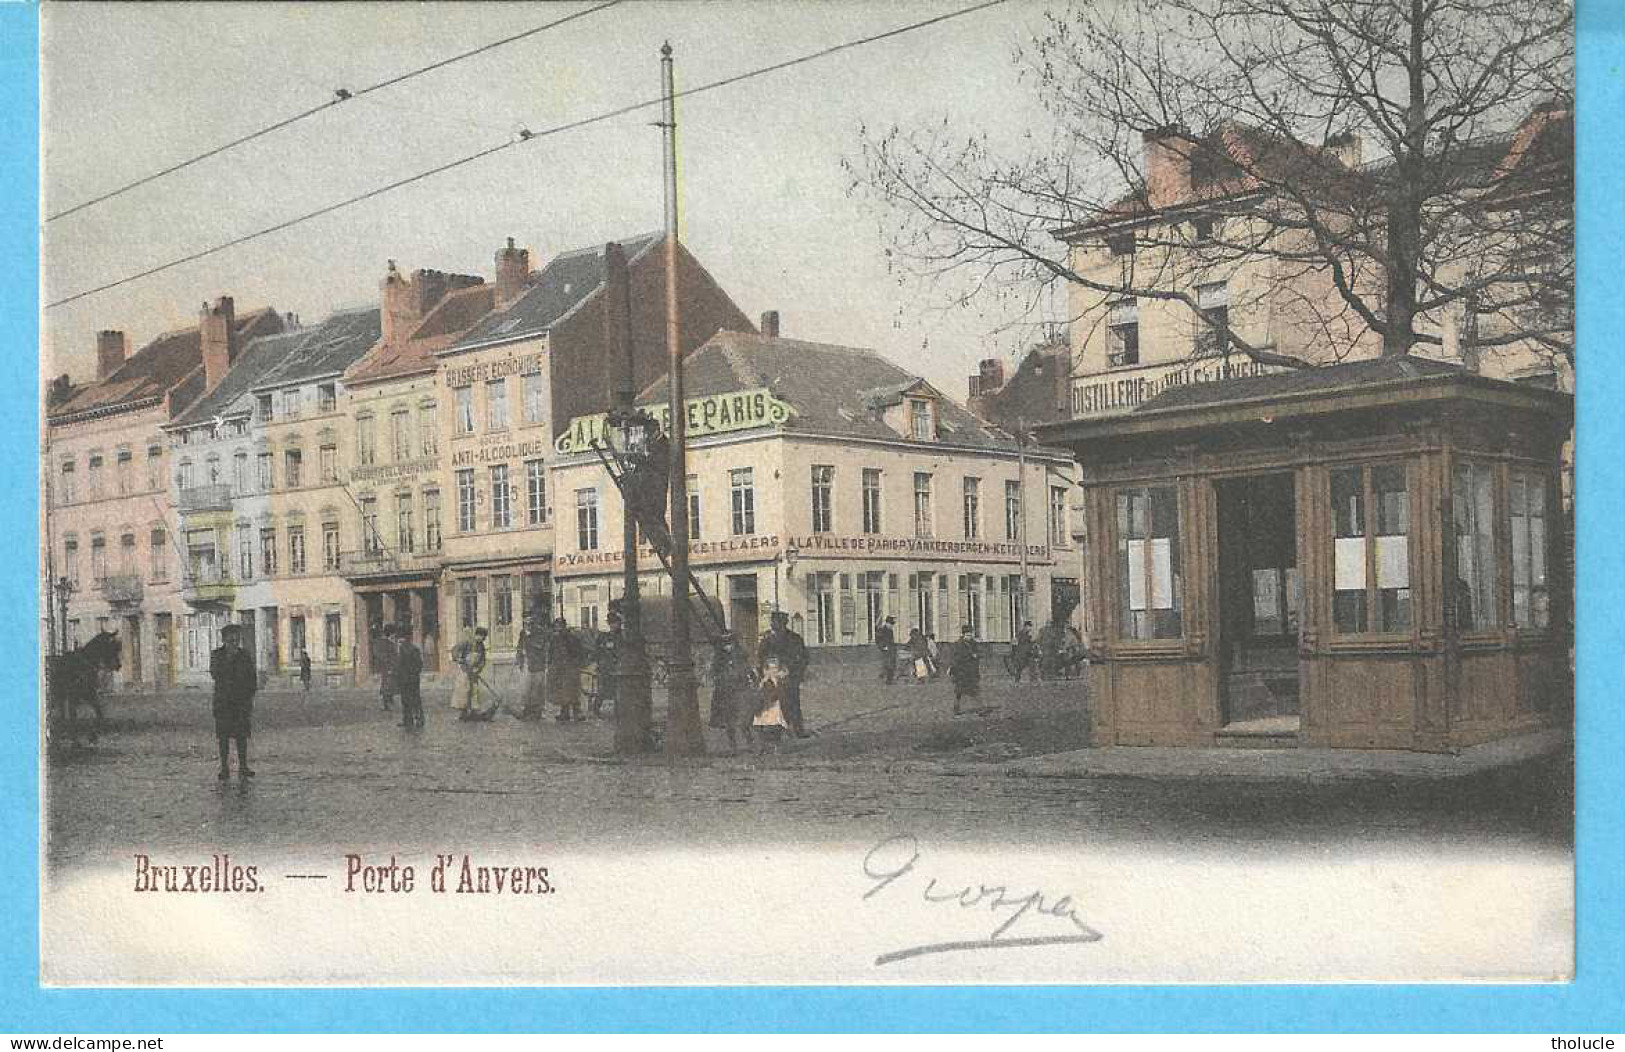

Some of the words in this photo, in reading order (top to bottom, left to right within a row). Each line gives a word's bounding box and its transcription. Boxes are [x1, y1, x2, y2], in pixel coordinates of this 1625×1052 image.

[702, 394, 765, 430] PARIS
[1072, 376, 1145, 414] DISTILLERIE
[452, 441, 542, 467] ANTI-ALCOOLIQUE
